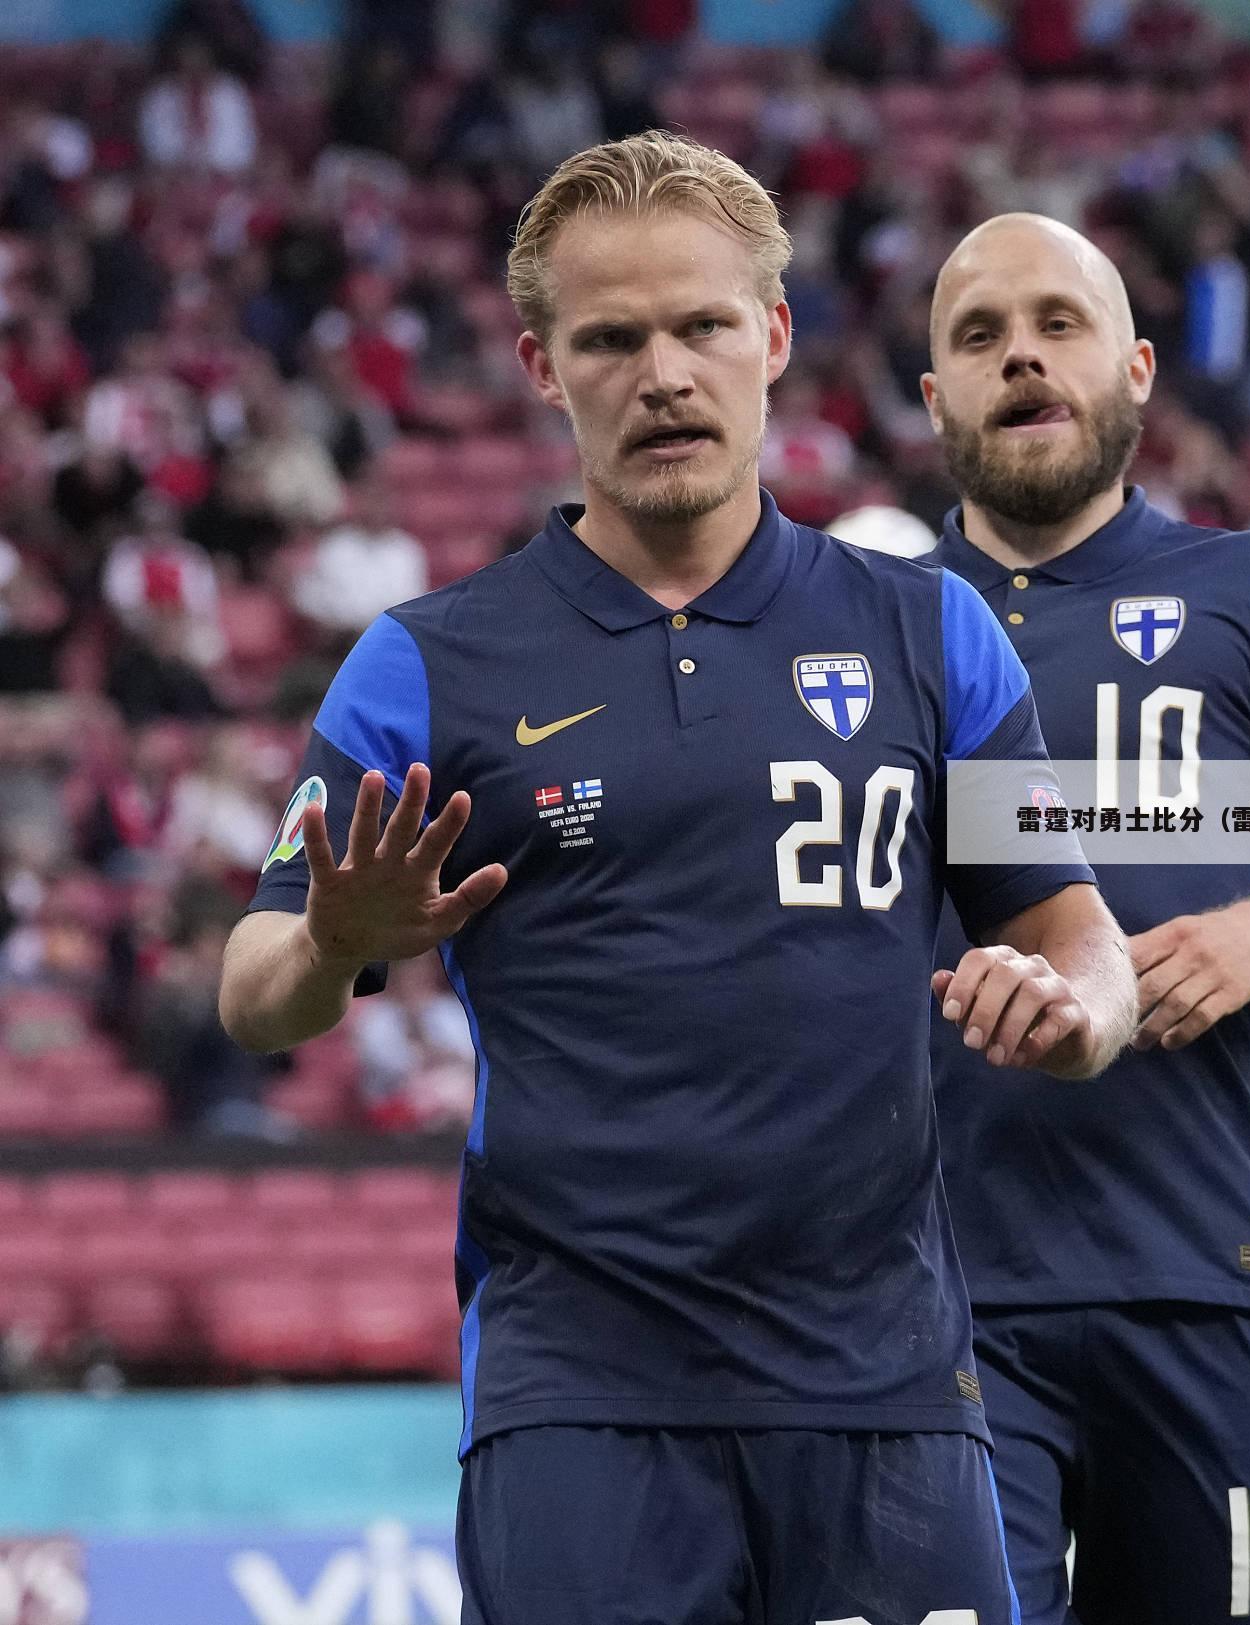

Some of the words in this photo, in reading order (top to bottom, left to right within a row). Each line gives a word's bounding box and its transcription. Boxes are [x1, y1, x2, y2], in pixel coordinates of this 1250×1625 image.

[807, 662, 856, 671] SUOMI
[1096, 682, 1203, 812] 10
[539, 807, 565, 818] DENMARK
[578, 801, 601, 811] FINLAND
[550, 819, 565, 827] UEFA
[565, 816, 579, 825] EURO
[580, 813, 594, 822] 2020
[559, 837, 594, 848] COPENHAGEN
[770, 760, 915, 910] 20
